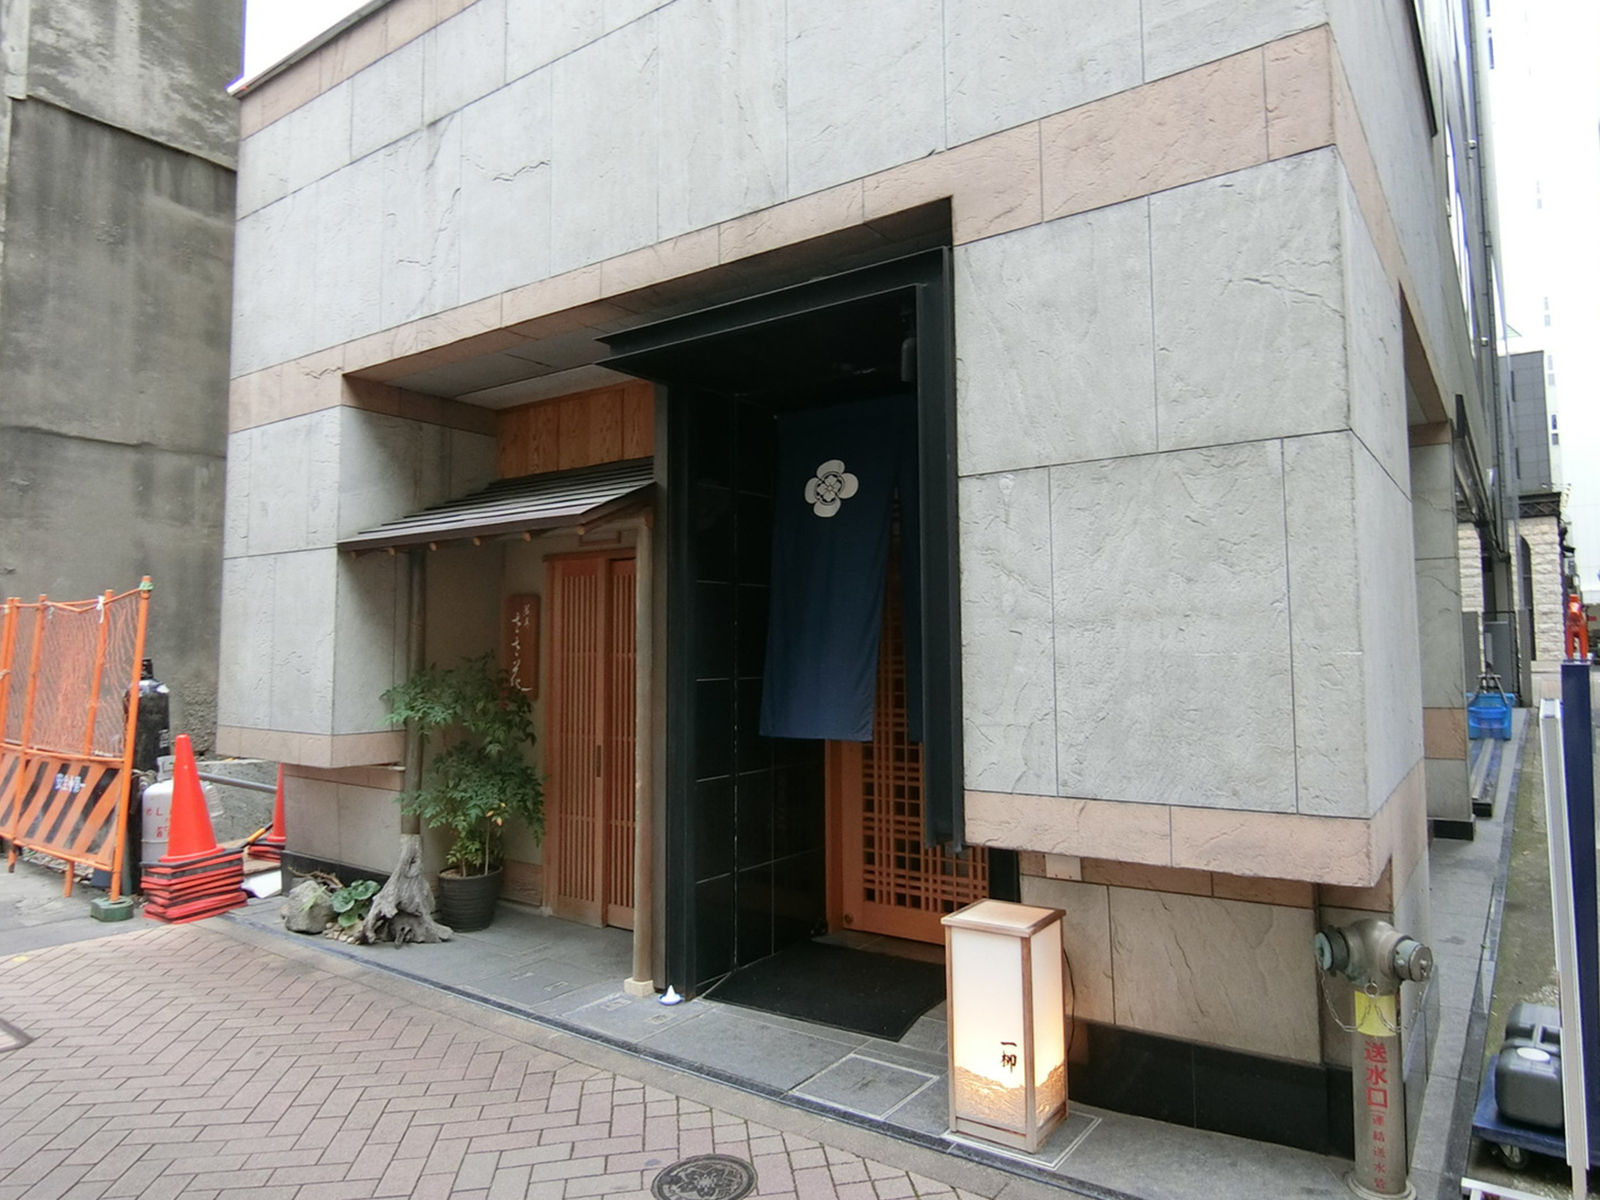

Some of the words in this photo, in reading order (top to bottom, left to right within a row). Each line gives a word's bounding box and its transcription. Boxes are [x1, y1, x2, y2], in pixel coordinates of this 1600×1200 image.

[999, 1040, 1018, 1074] 一柳
[1365, 1036, 1388, 1109] 送水口
